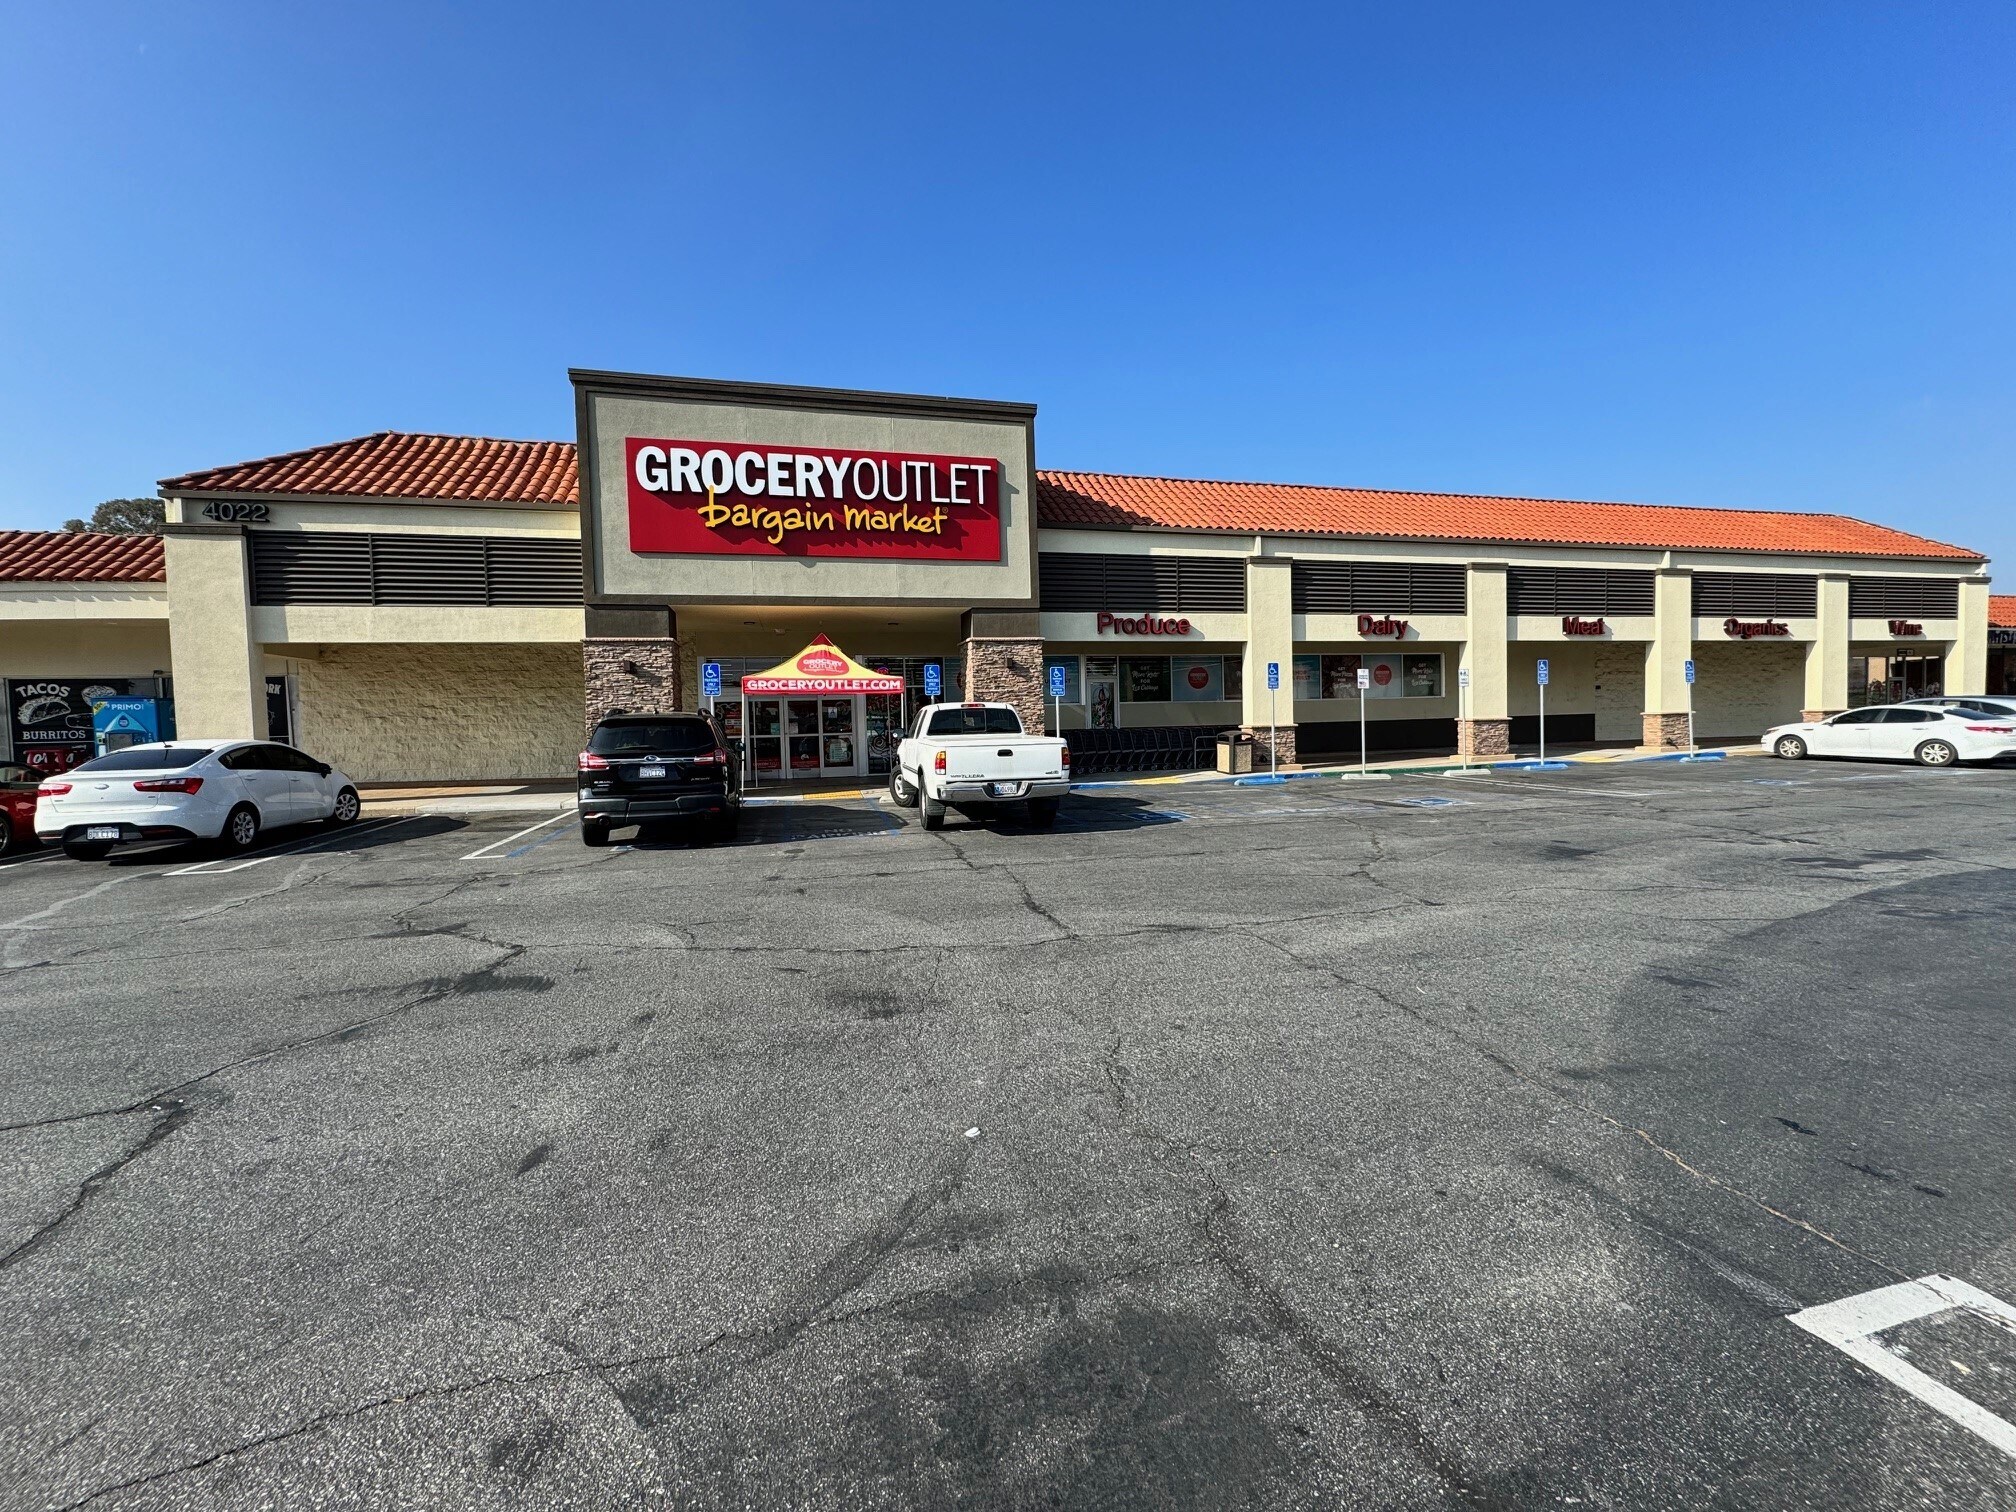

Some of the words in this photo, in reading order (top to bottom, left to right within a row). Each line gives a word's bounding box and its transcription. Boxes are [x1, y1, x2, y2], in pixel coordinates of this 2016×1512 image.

[202, 502, 269, 522] 4022
[698, 485, 834, 544] bargain
[845, 503, 948, 535] market
[1097, 612, 1191, 635] Produce
[1358, 614, 1408, 640] Dairy
[1562, 616, 1605, 635] Meat
[1723, 617, 1789, 640] Organics
[1888, 620, 1923, 636] Wine
[803, 658, 843, 667] GROCERY
[15, 683, 71, 698] TACOS
[747, 679, 901, 691] GROCERYOUTLET.COM
[111, 703, 141, 711] PRIMO
[22, 730, 86, 741] BURRITOS
